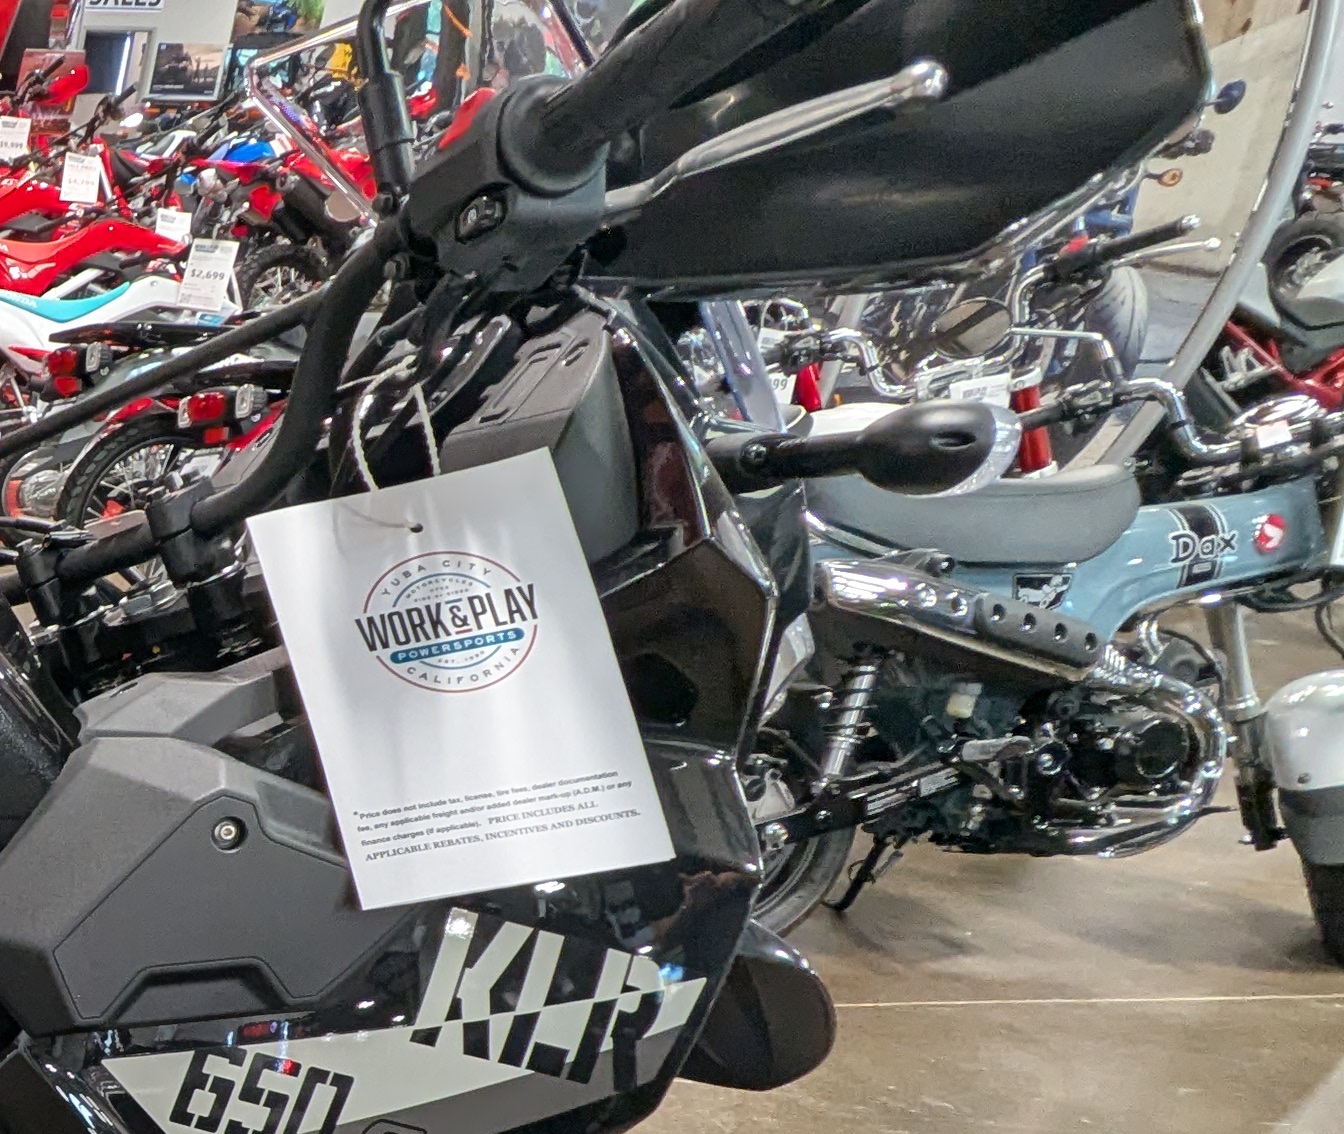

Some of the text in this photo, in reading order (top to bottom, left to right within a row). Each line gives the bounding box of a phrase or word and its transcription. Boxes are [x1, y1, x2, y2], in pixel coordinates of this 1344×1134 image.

[191, 268, 225, 281] $2,699
[1169, 530, 1238, 564] Dax
[381, 559, 492, 598] YUBA CITY
[355, 583, 538, 652] WORK&PLAY
[397, 631, 518, 661] POWERSPORTS
[406, 646, 520, 685] CALIFORNIA
[374, 821, 389, 830] any
[390, 814, 431, 828] applicable
[432, 808, 458, 820] freight
[486, 800, 511, 810] added
[513, 796, 537, 806] dealer
[538, 790, 572, 802] mark-up
[617, 780, 632, 789] any
[382, 807, 401, 816] does
[404, 804, 417, 812] not
[418, 799, 447, 809] include
[448, 797, 463, 805] tax,
[464, 792, 495, 802] license,
[532, 781, 556, 791] dealer
[558, 770, 618, 786] documentation
[361, 836, 391, 847] finance
[393, 830, 424, 841] charges
[488, 813, 520, 825] PRICE
[522, 803, 575, 820] INCLUDES
[577, 801, 599, 812] ALL
[365, 808, 641, 861] APPLICABLE REBATES, INCENTIVES AND DISCOUNTS.
[409, 906, 668, 1091] KLR
